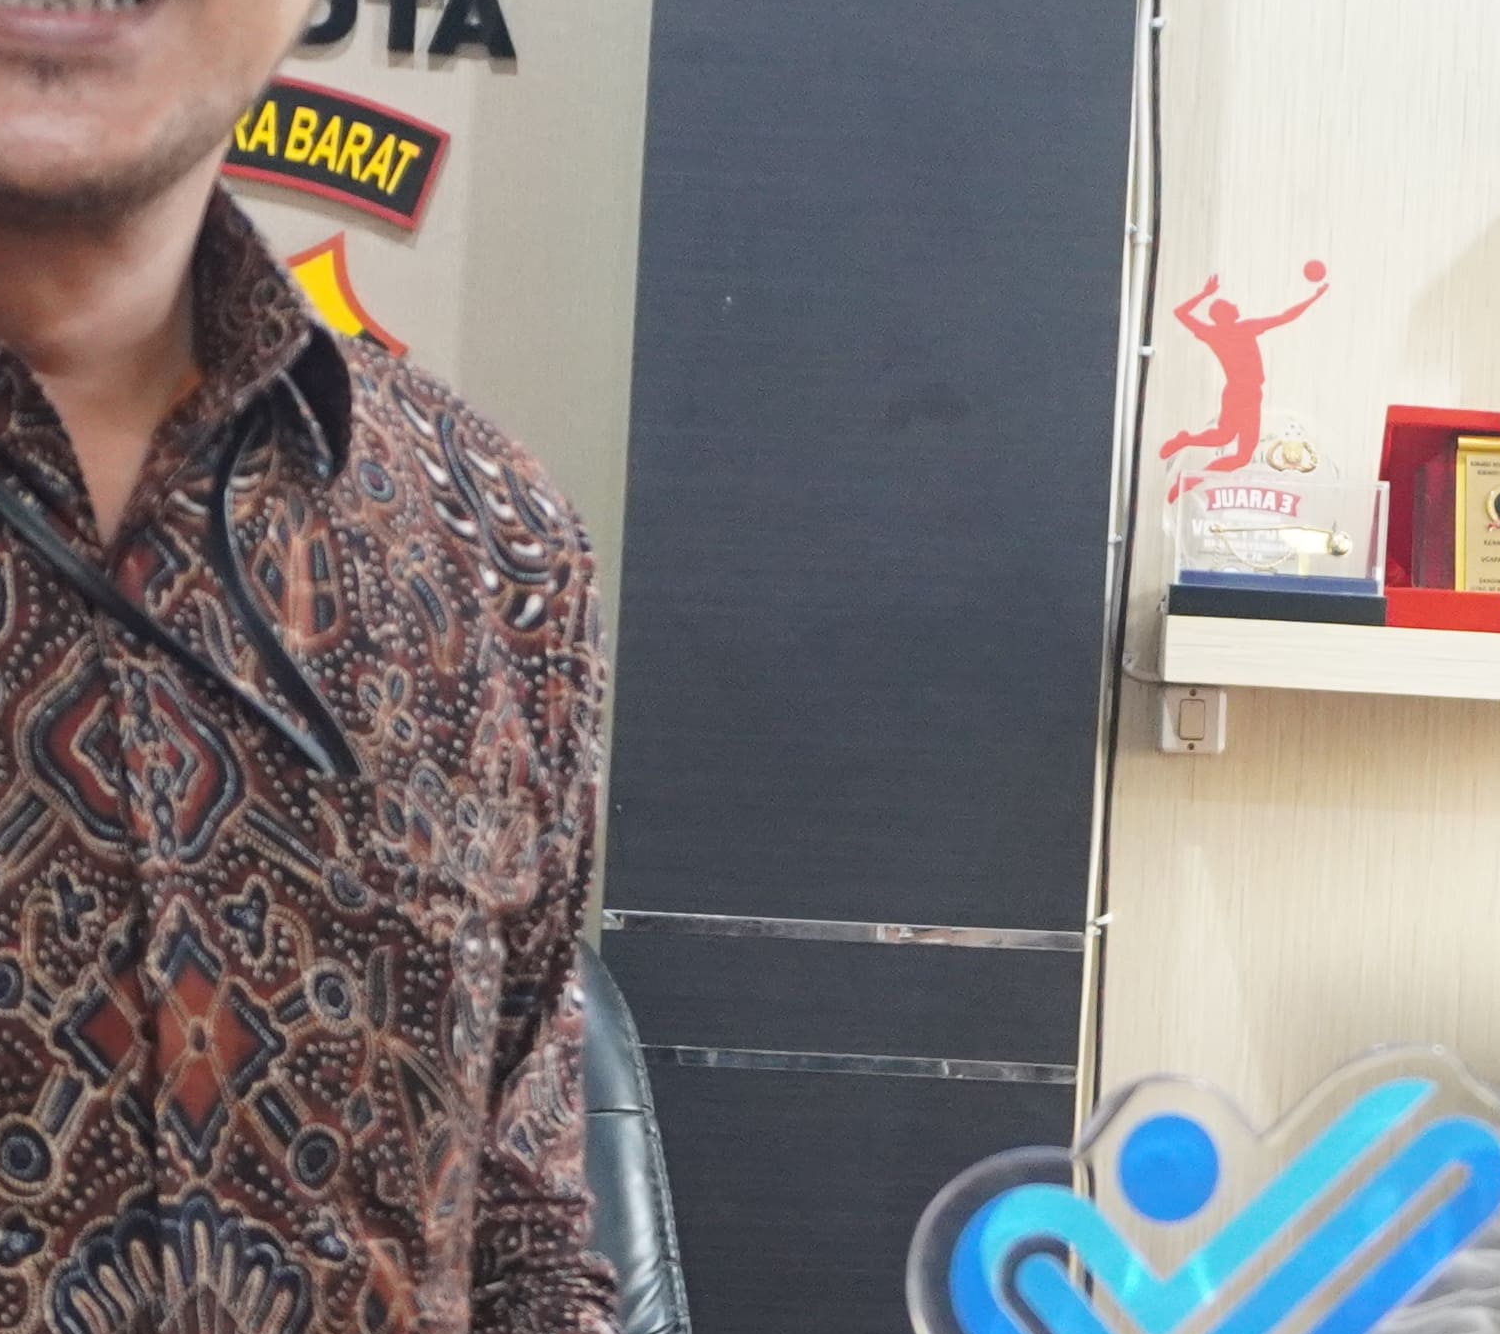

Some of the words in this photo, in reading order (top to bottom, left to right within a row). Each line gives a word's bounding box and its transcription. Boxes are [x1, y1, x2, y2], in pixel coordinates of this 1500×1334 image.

[284, 106, 421, 195] BARAT
[1212, 488, 1275, 511] JUARA
[1279, 494, 1295, 514] 3
